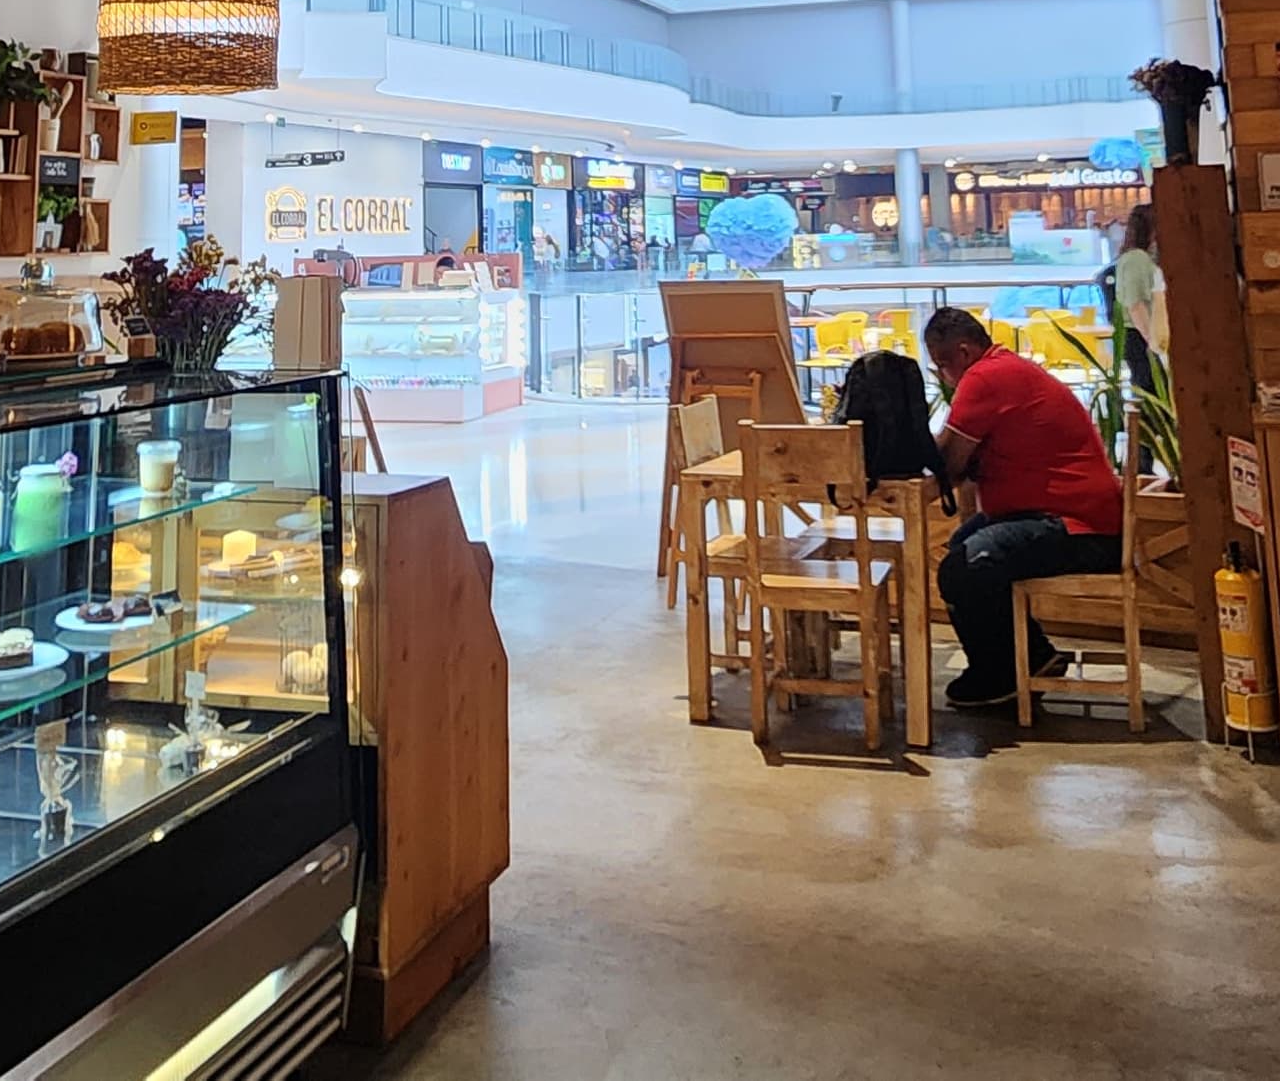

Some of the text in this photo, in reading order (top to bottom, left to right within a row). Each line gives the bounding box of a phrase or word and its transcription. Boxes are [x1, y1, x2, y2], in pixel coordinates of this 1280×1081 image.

[303, 153, 312, 166] 3
[1081, 167, 1138, 185] Gusto
[272, 212, 306, 226] EL CORRAL
[318, 197, 411, 233] EL CORRAL
